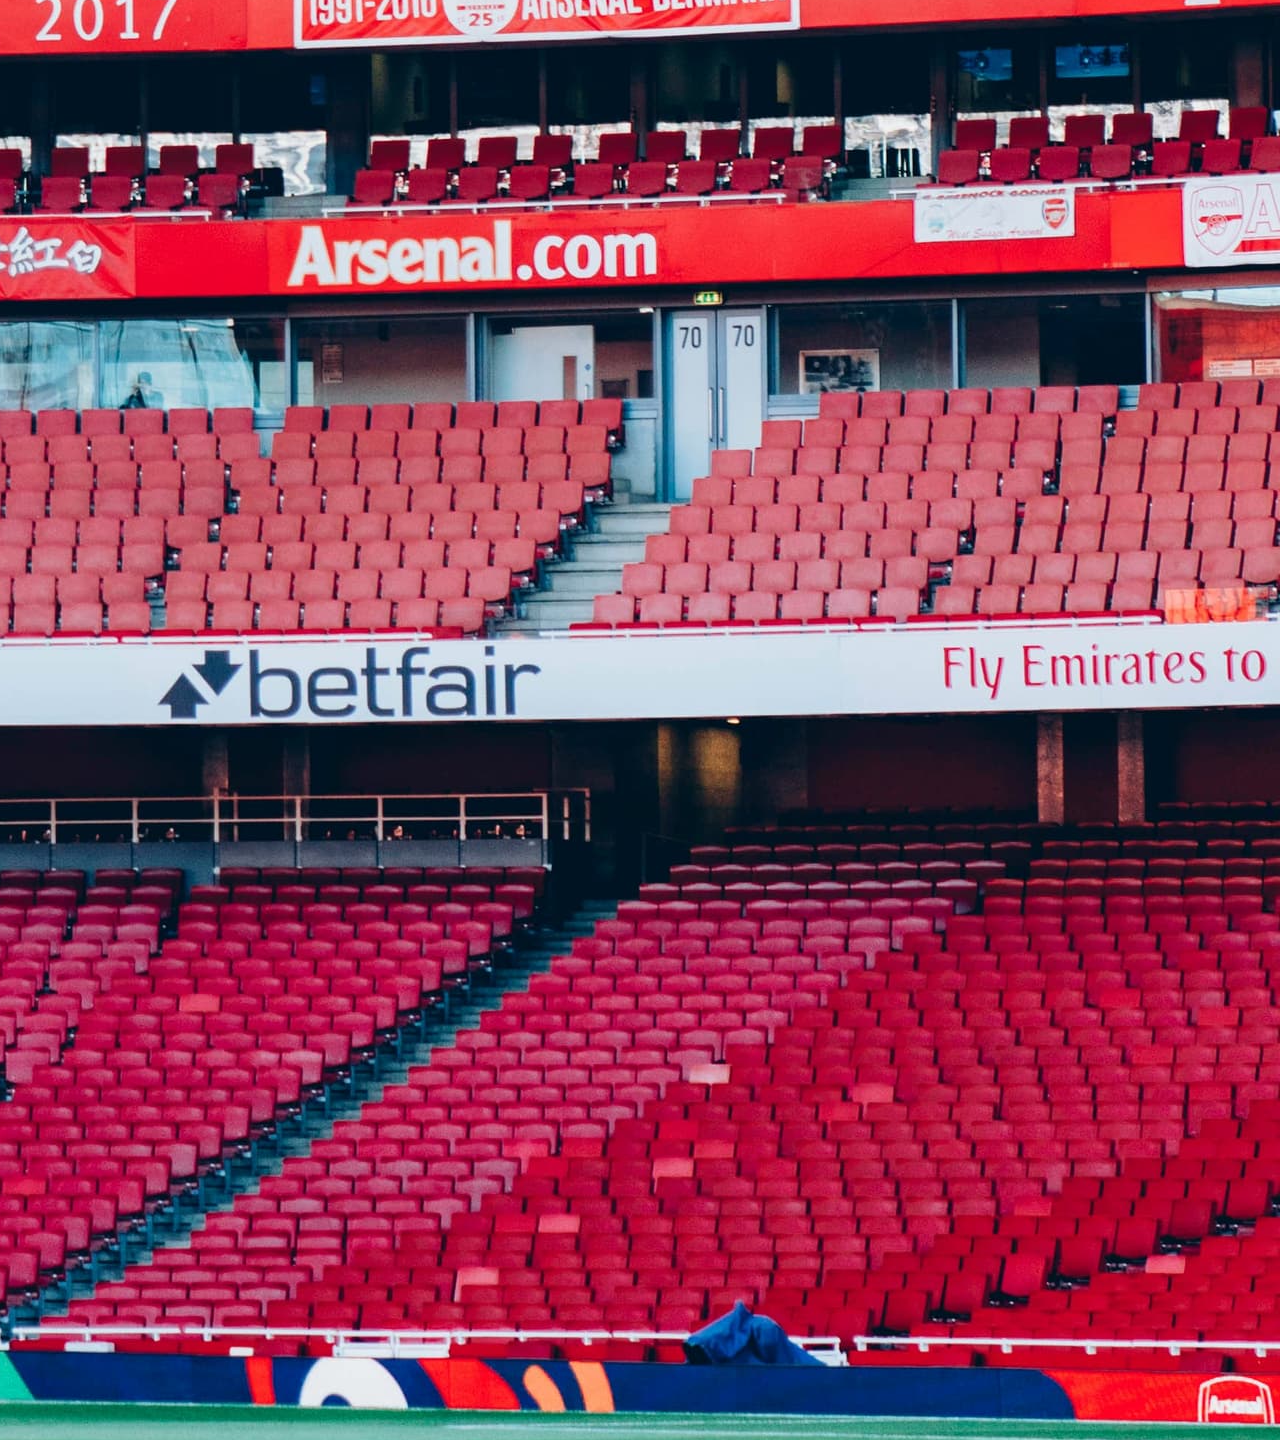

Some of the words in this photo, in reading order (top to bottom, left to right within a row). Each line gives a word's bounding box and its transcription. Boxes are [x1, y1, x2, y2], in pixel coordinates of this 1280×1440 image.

[288, 219, 657, 287] Arsenal.com
[679, 326, 702, 349] 70
[732, 324, 754, 347] 70
[248, 645, 541, 718] betfair
[943, 645, 1005, 700] Fly
[1022, 643, 1207, 688] Emirates
[1223, 648, 1267, 683] to
